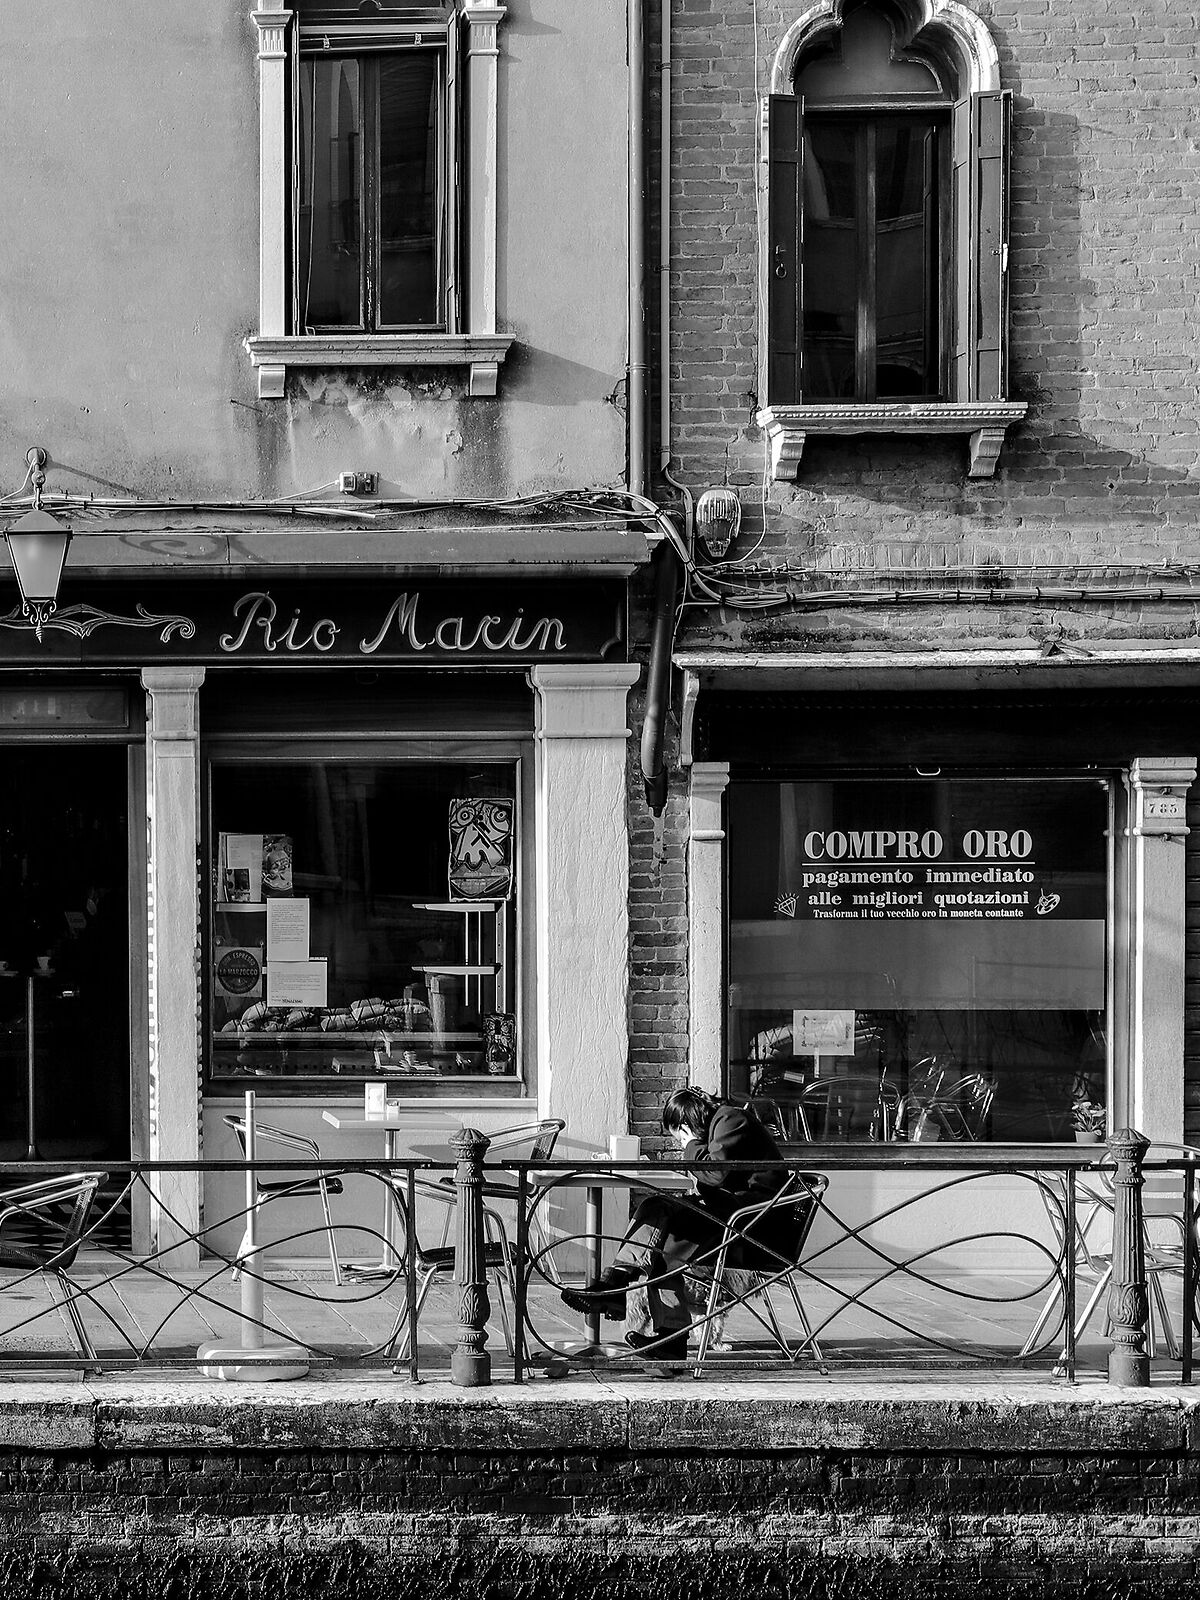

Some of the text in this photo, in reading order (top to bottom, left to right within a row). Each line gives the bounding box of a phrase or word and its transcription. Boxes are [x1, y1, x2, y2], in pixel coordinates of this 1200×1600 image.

[218, 591, 568, 654] Rio Marin
[1149, 803, 1177, 814] 785
[803, 829, 1033, 860] COMPRO ORO
[802, 867, 1035, 888] pagamento immediato
[807, 890, 1030, 908] alle migliori quotazioni
[812, 908, 1024, 918] Trasforma il tuo vecchio oro in moneta contante
